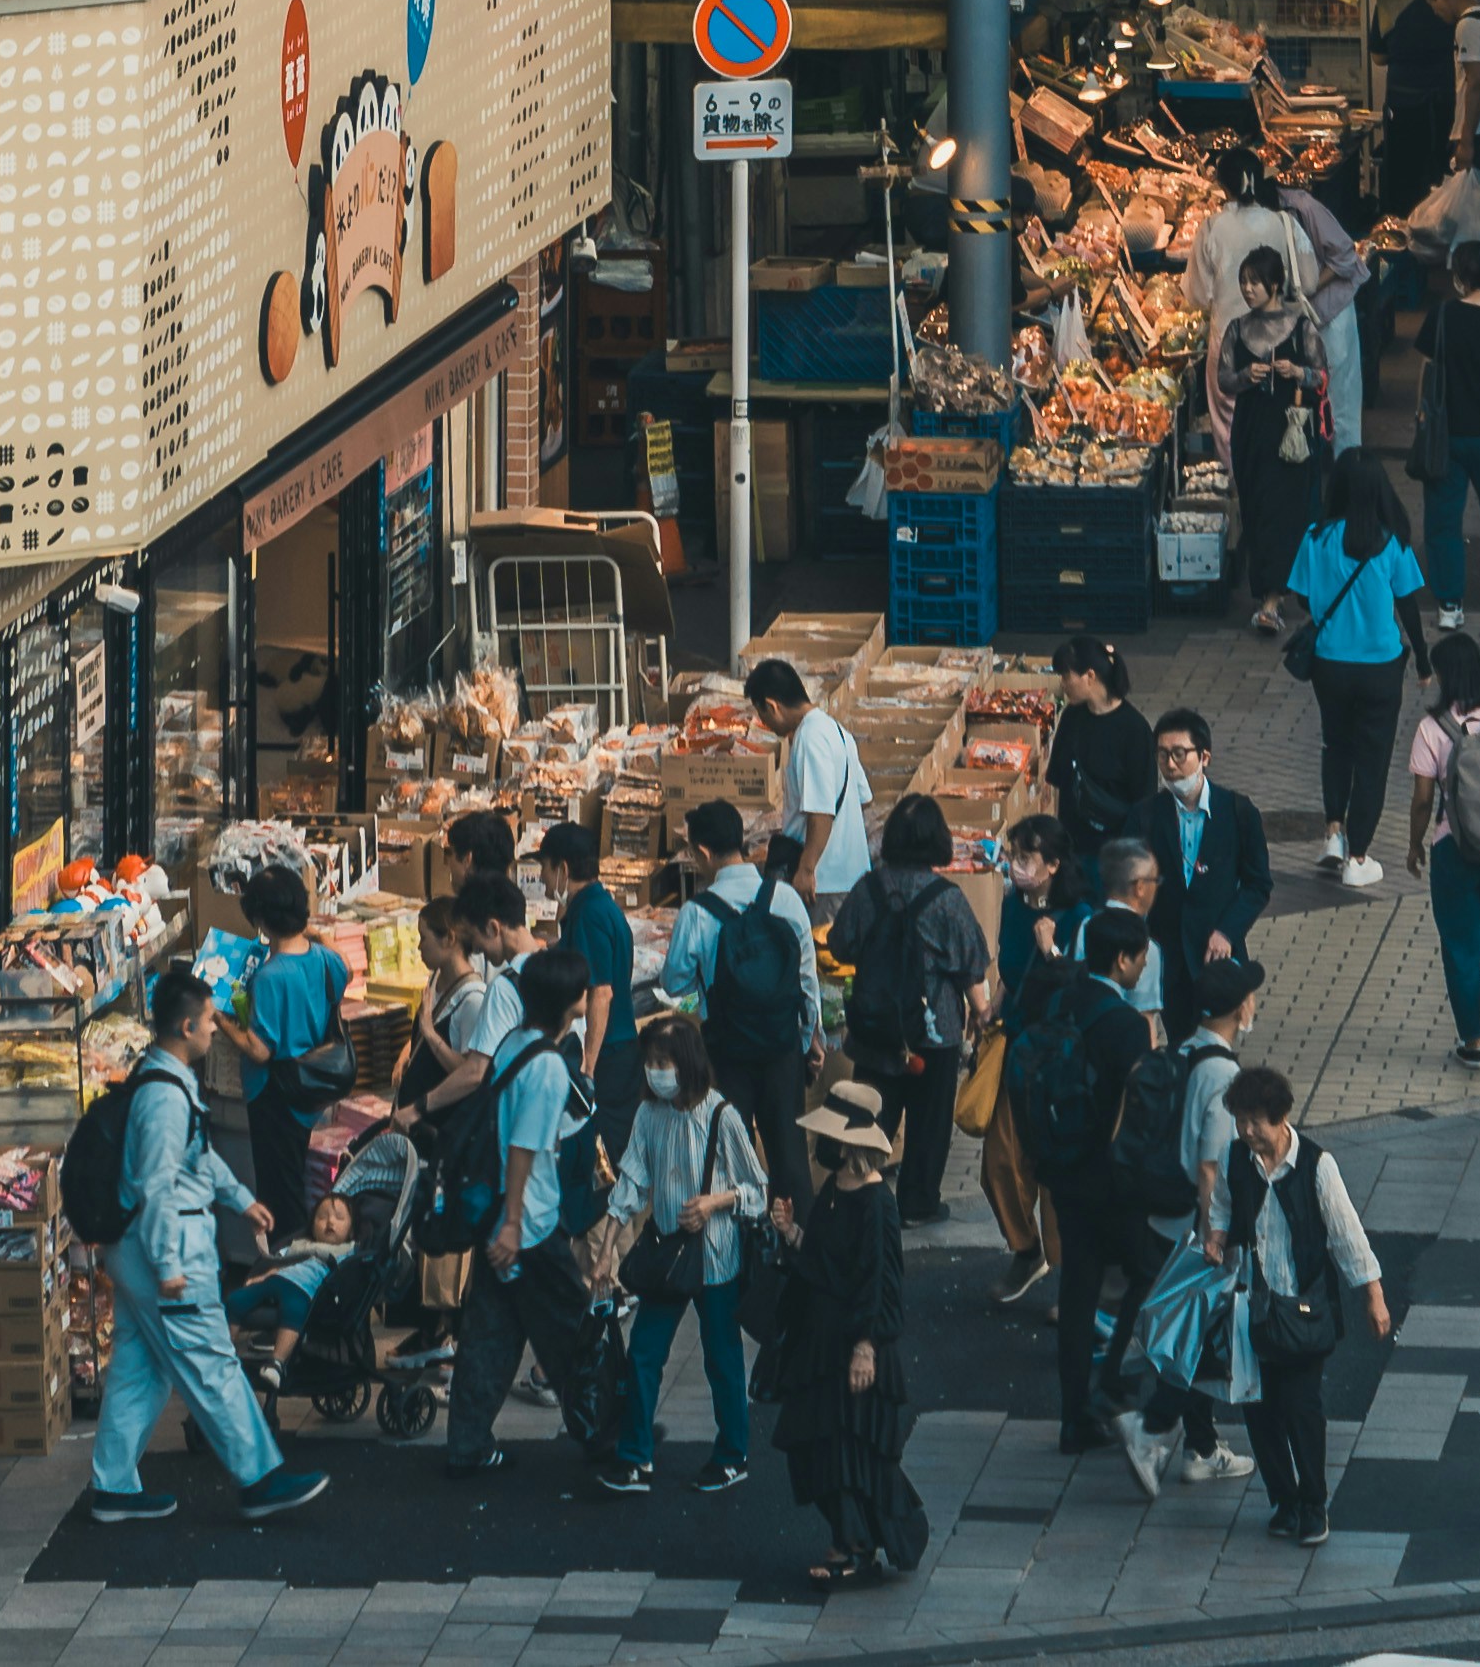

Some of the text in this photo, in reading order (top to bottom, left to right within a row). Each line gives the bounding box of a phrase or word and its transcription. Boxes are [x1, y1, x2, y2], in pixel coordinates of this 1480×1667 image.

[702, 112, 785, 136] 貨物を除く
[379, 244, 394, 274] CAFE
[424, 386, 445, 414] NIKI
[448, 355, 481, 397] BAKERY
[484, 348, 492, 369] &
[269, 481, 306, 527] BAKERY
[309, 472, 316, 496] &
[320, 449, 345, 487] CAFE
